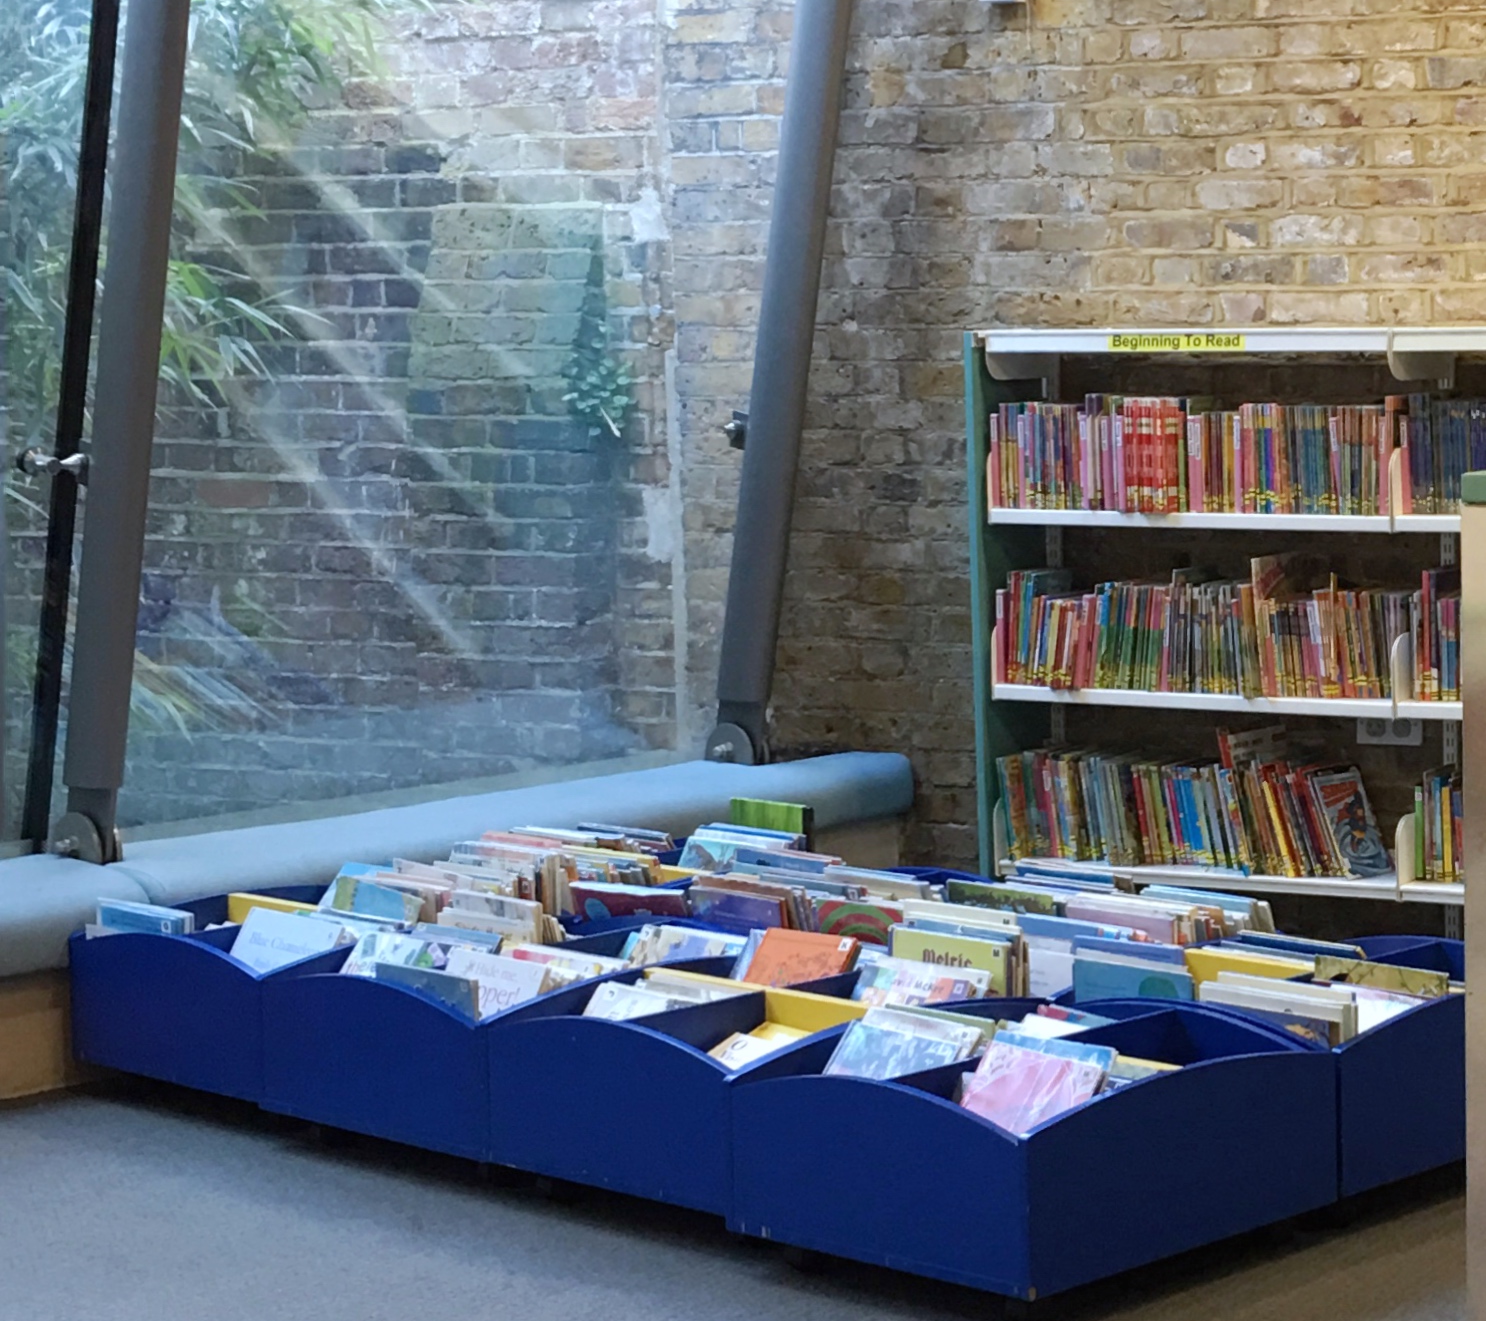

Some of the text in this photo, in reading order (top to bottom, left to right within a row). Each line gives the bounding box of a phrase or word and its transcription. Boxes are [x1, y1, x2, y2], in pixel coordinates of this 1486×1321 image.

[1111, 333, 1241, 351] Beginning To Read
